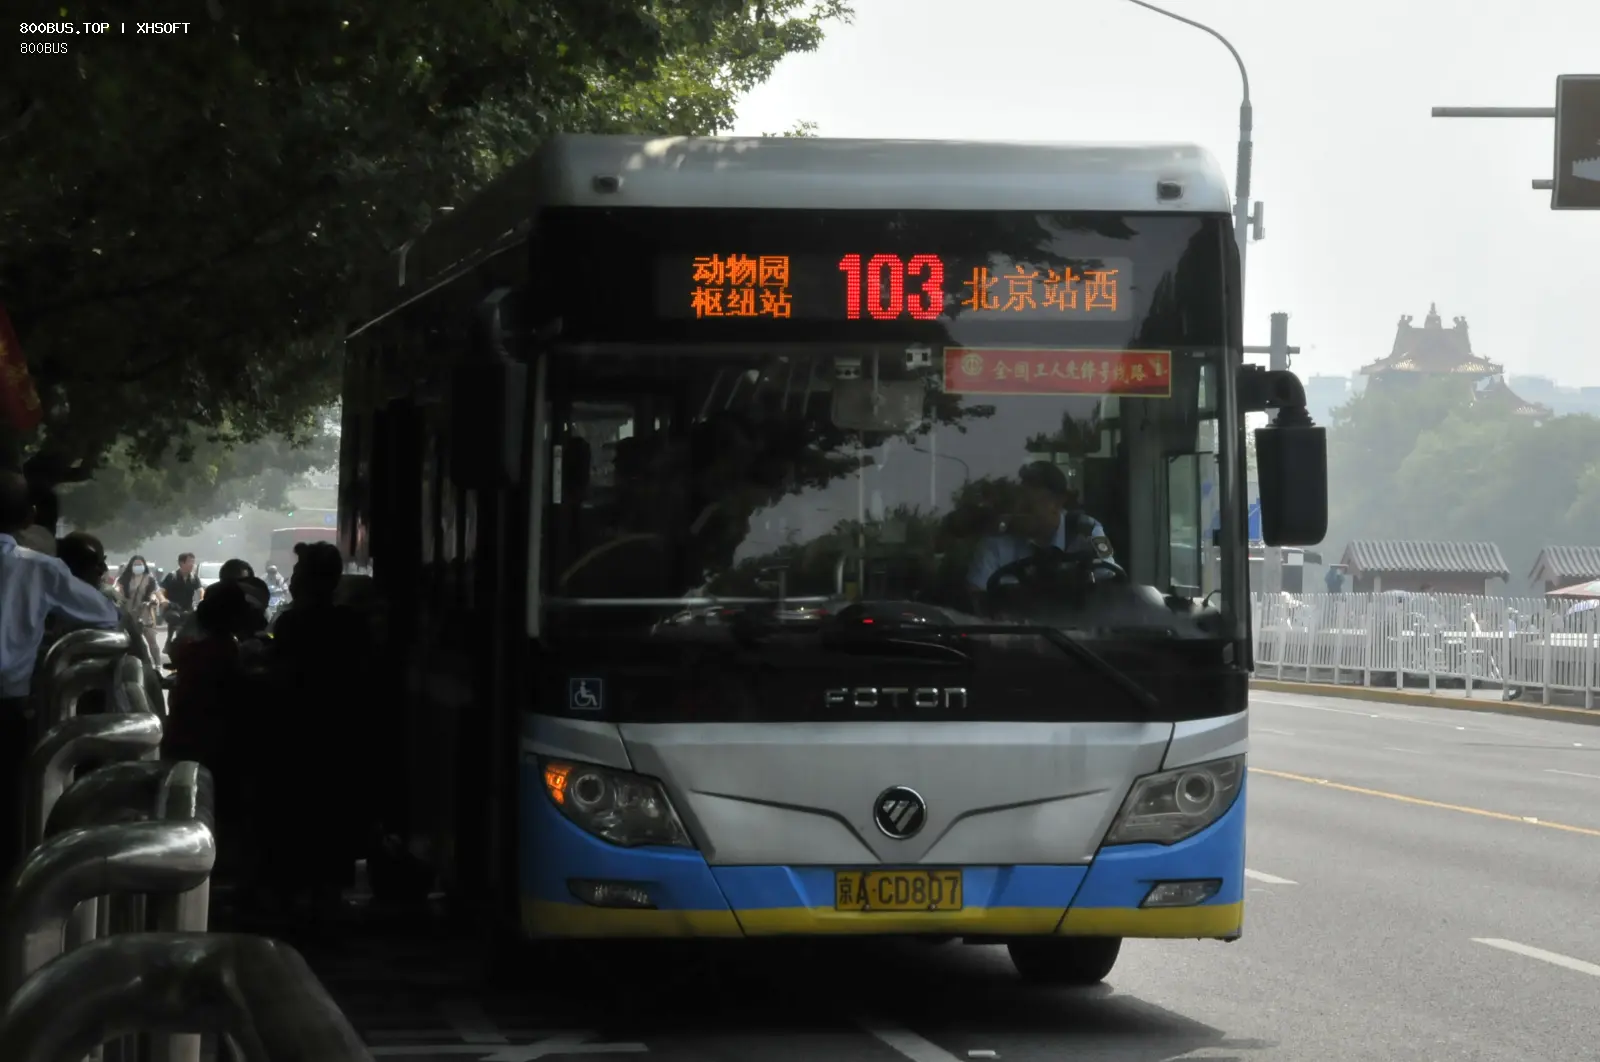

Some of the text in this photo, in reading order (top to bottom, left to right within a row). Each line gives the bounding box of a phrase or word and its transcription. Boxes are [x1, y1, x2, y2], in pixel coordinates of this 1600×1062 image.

[692, 254, 789, 287] 动物园
[839, 253, 944, 320] 103
[691, 287, 792, 319] 枢纽站
[961, 265, 1119, 312] 北京站西
[825, 687, 967, 708] FOTON
